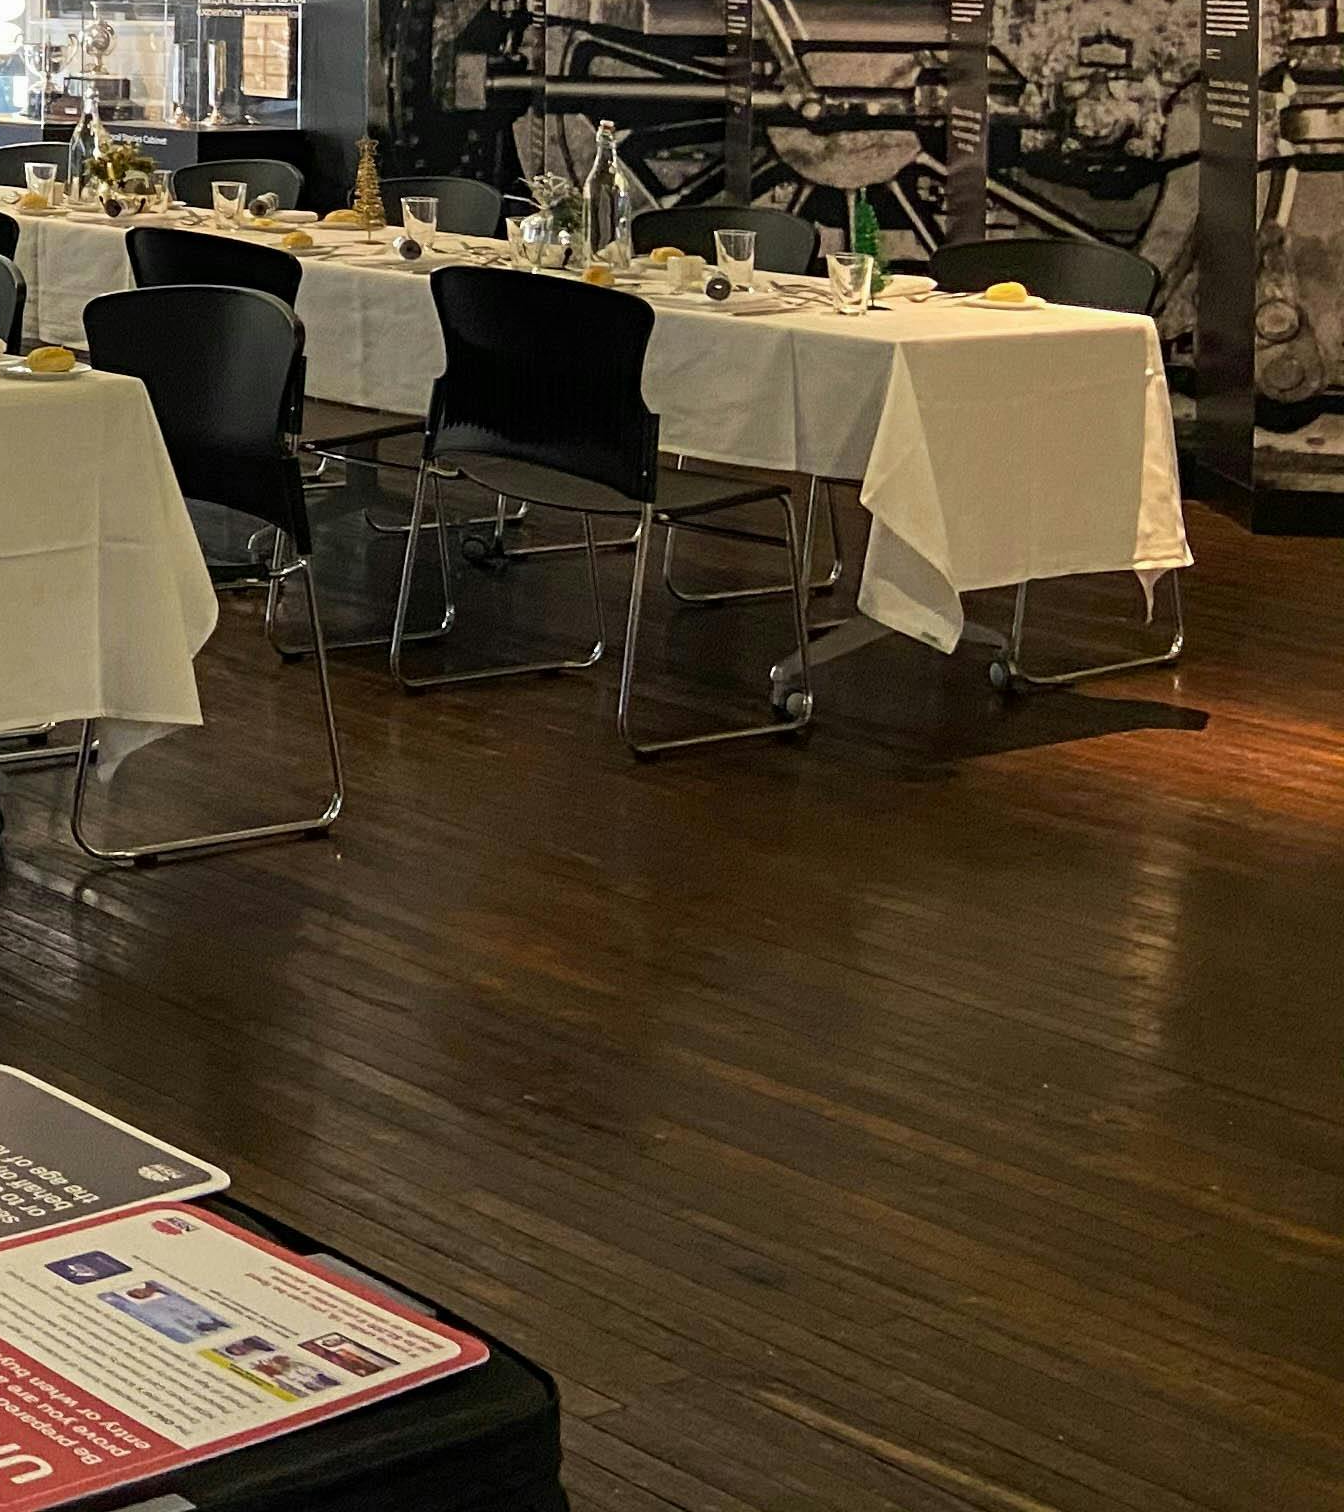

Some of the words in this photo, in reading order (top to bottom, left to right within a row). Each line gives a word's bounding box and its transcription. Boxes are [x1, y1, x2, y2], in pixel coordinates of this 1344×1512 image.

[0, 1156, 33, 1167] of
[29, 1167, 68, 1185] age
[0, 1193, 25, 1205] to
[6, 1179, 74, 1211] behalf
[63, 1185, 100, 1203] the
[18, 1205, 46, 1216] or
[7, 1385, 39, 1403] are
[29, 1377, 78, 1407] when
[37, 1403, 78, 1425] you
[76, 1409, 101, 1420] or
[72, 1426, 131, 1457] prove
[99, 1422, 151, 1449] entry
[74, 1447, 103, 1465] Be
